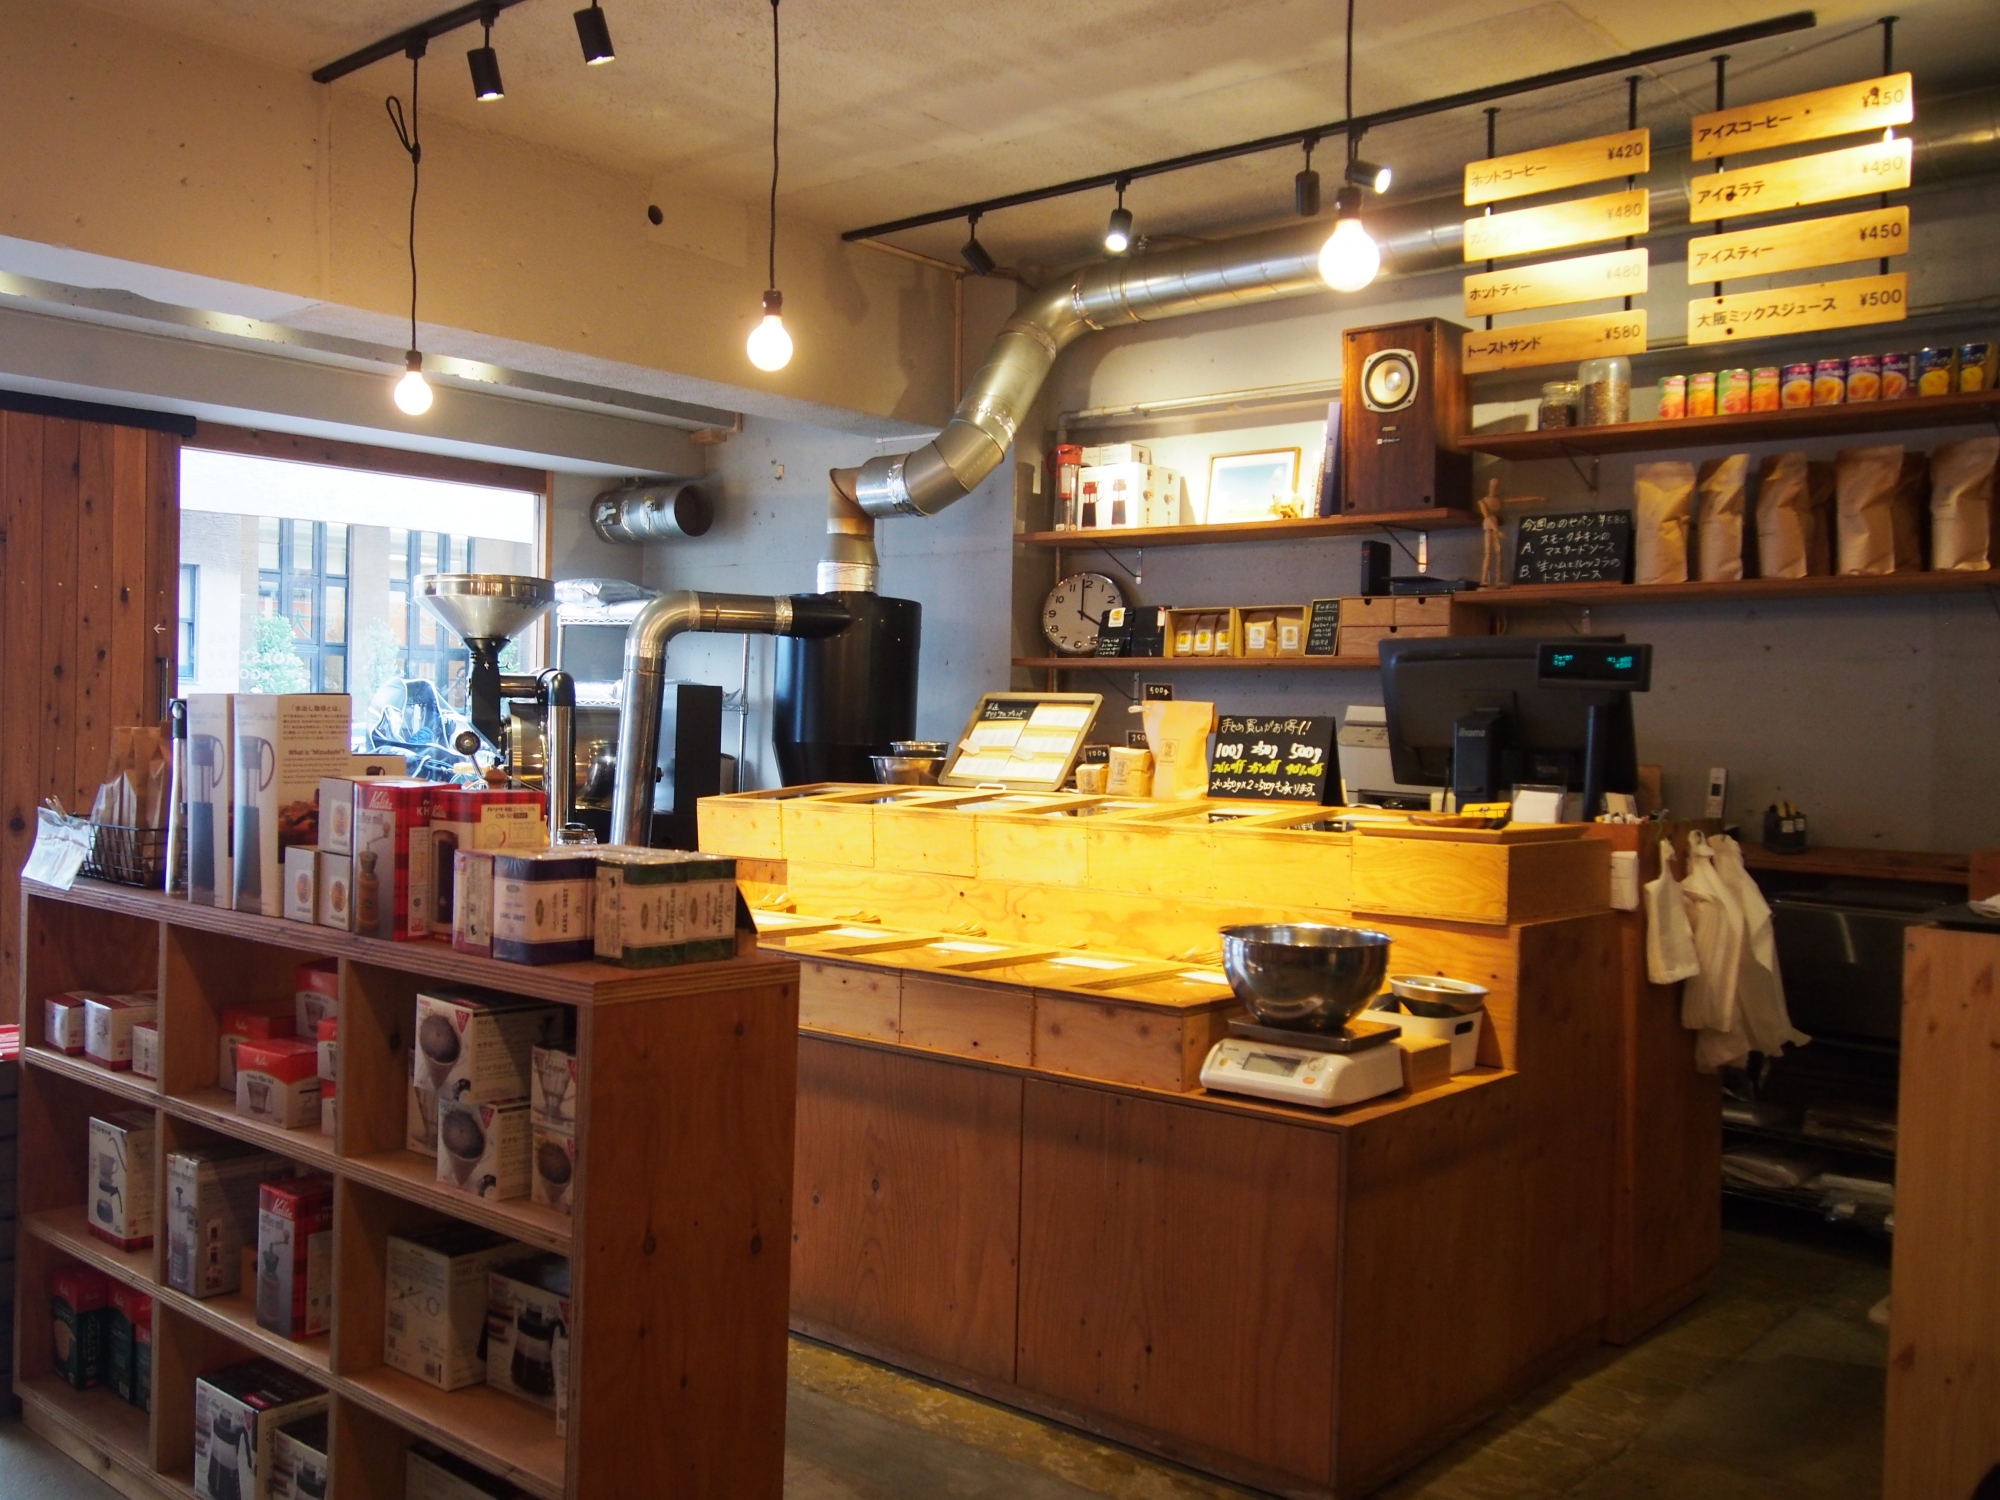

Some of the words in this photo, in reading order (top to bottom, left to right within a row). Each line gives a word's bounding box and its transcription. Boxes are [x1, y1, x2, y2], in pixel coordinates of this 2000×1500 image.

[1698, 113, 1793, 142] アイスコーヒー
[1861, 88, 1905, 110] ¥450
[1470, 163, 1547, 187] ホットコーヒー
[1607, 142, 1643, 160] ¥420
[1861, 155, 1905, 176] ¥480
[1607, 203, 1642, 219] ¥480
[1696, 244, 1775, 266] アイスティー
[1859, 222, 1902, 242] ¥450
[1469, 283, 1531, 301] ホットティー
[1606, 264, 1641, 280] ¥480
[1696, 297, 1837, 329] 大阪ミックスジュース
[1859, 289, 1902, 308] ¥500
[1467, 336, 1542, 358] トーストサンド
[1604, 324, 1641, 340] ¥580
[1215, 742, 1244, 760] 100g
[1288, 742, 1323, 764] 500g
[369, 790, 393, 810] Kalita
[272, 1198, 293, 1219] Kalita
